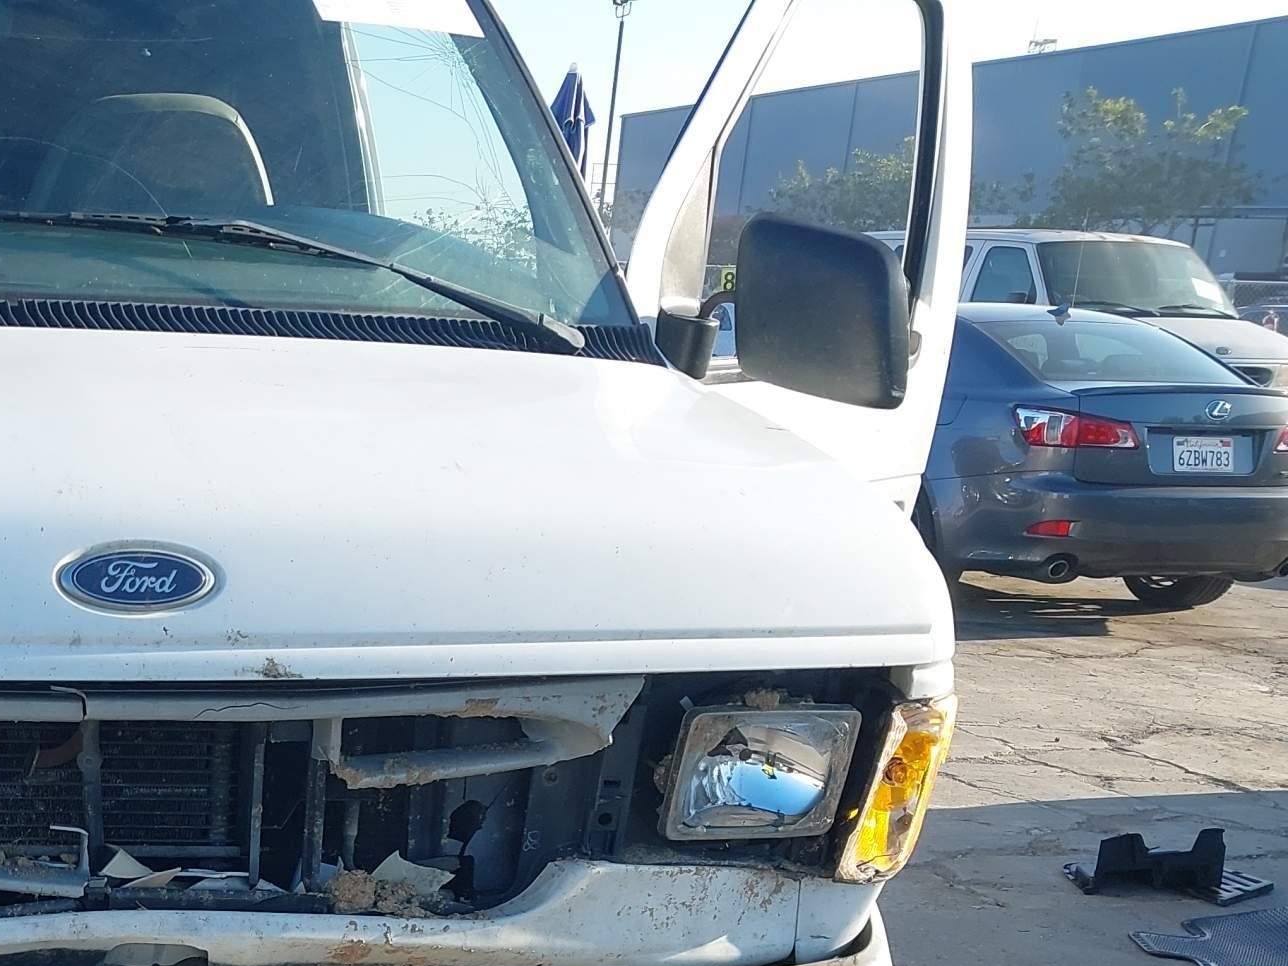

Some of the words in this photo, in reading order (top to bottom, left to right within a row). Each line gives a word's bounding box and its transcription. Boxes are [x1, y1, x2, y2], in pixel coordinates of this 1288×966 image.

[723, 271, 735, 291] 8
[1178, 449, 1230, 467] 6ZBW783
[100, 559, 178, 594] Ford
